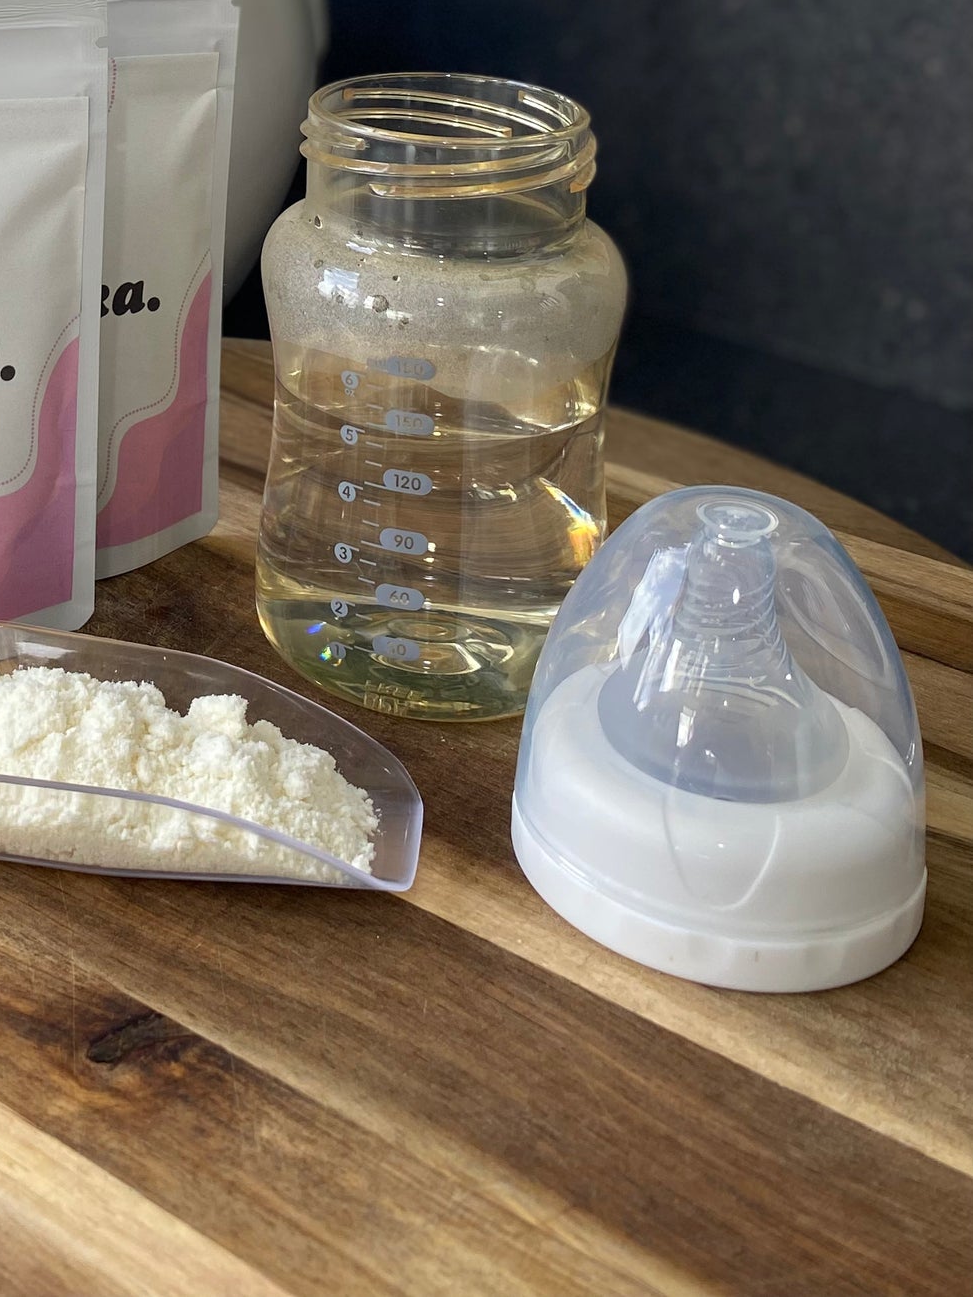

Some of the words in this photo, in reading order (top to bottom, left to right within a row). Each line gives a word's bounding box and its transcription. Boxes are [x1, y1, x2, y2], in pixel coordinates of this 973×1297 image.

[393, 473, 422, 491] 120
[394, 534, 414, 550] 90
[389, 590, 410, 606] 60
